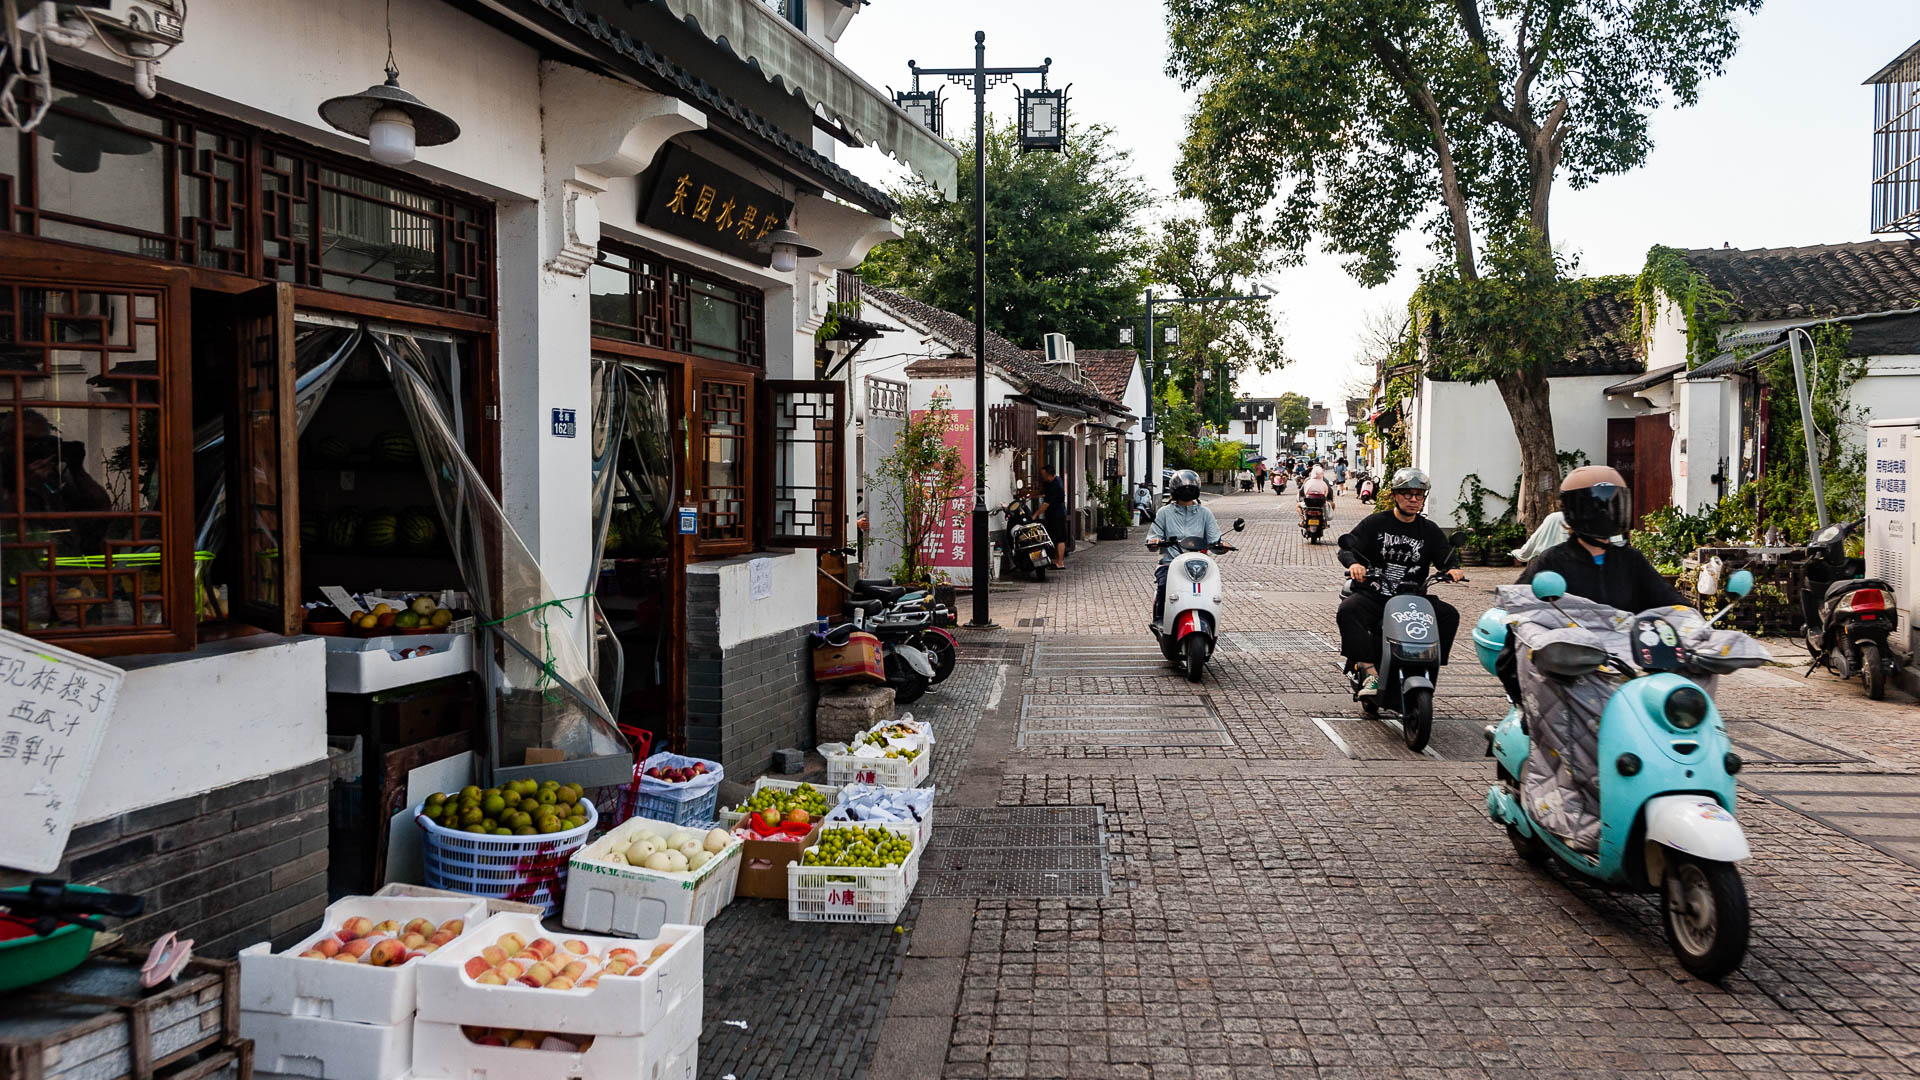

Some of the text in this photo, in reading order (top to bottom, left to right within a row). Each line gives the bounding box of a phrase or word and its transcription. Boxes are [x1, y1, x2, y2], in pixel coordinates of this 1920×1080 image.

[666, 172, 779, 240] 东园水果店
[554, 422, 567, 434] 162
[1876, 459, 1906, 474] 用有线电视
[1875, 478, 1906, 493] 看4K超高清
[1875, 497, 1906, 512] 上高速宽带
[951, 485, 967, 561] 一站式服务
[8, 700, 80, 737] 西瓜汁
[0, 731, 65, 774] 雪梨汁
[855, 770, 876, 784] 小唐
[828, 889, 855, 906] 小唐
